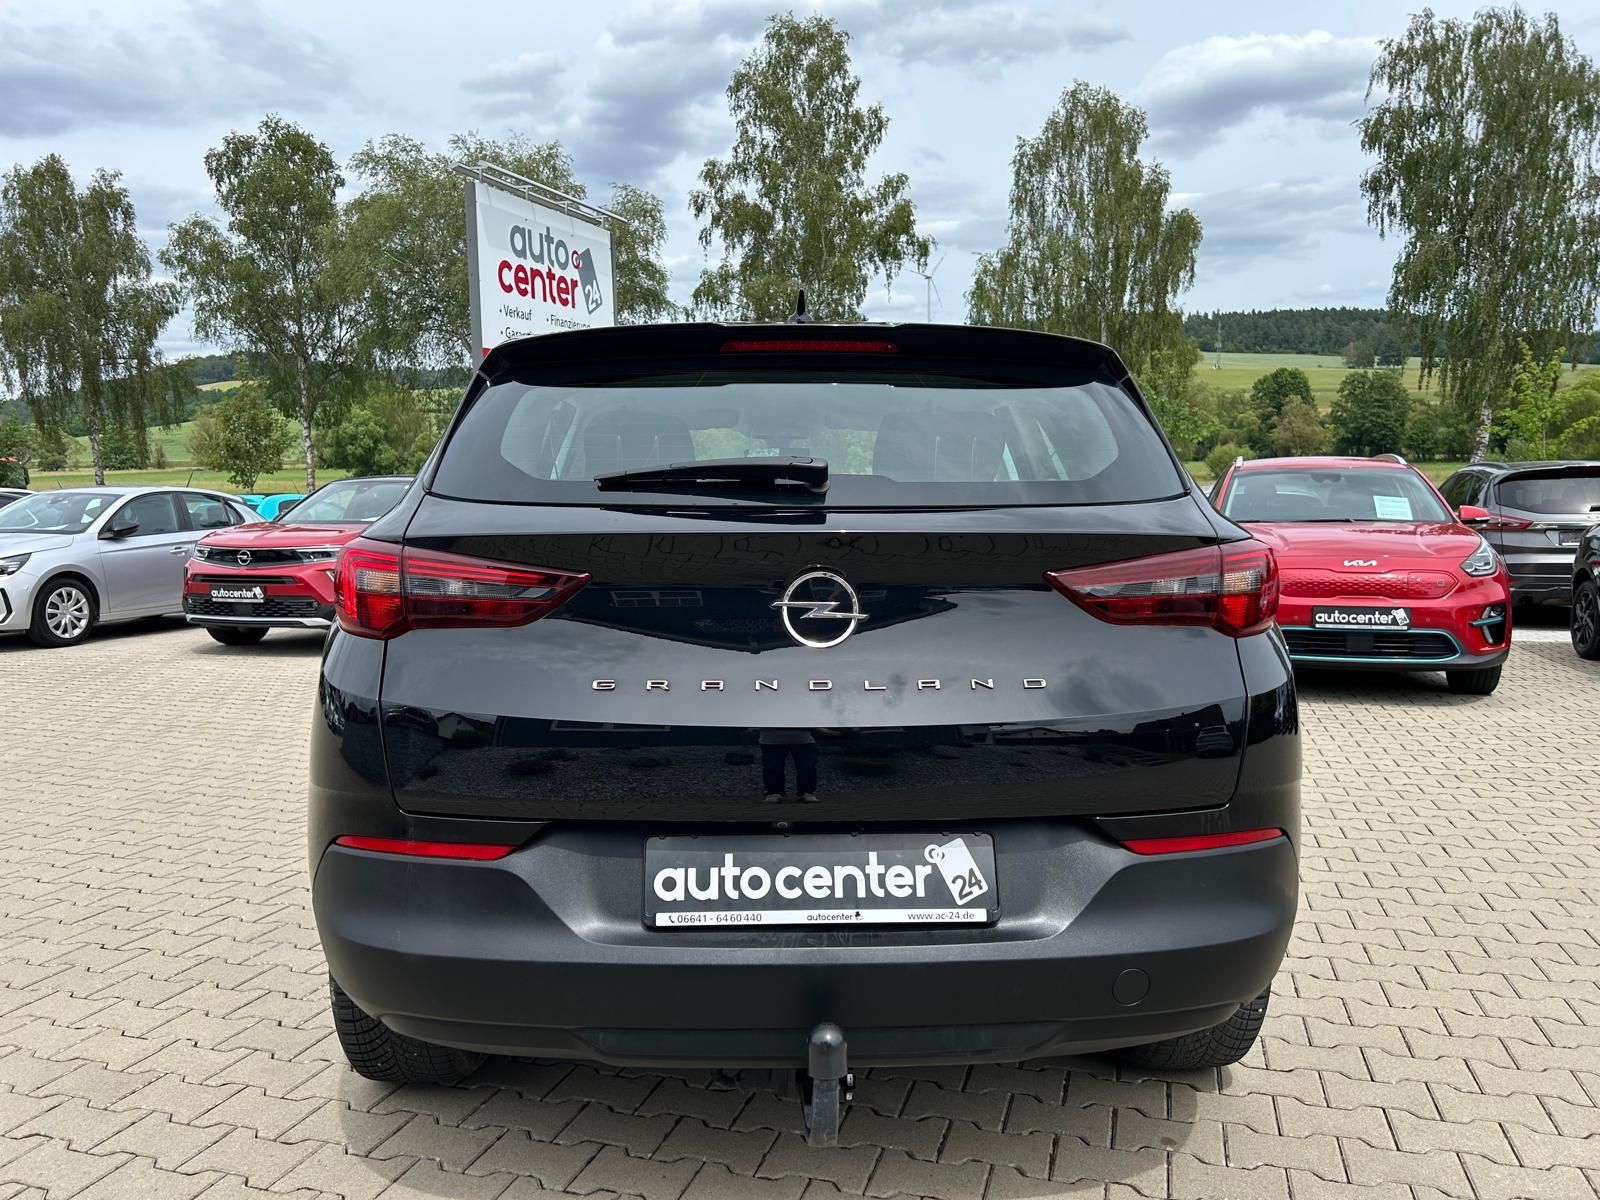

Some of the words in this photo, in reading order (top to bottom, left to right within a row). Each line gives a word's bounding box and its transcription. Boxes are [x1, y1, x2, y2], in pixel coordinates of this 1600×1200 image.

[509, 223, 570, 270] auto
[498, 259, 579, 309] center
[585, 280, 601, 309] 24
[503, 304, 532, 320] Verkauf
[211, 587, 254, 598] autocenter
[1315, 609, 1394, 624] autocenter
[591, 678, 1048, 692] GRANDLAND
[653, 851, 932, 902] autocenter
[951, 868, 984, 901] 24
[677, 914, 707, 924] 06641
[806, 913, 853, 922] autocenter
[907, 911, 975, 921] www.ac-24.de
